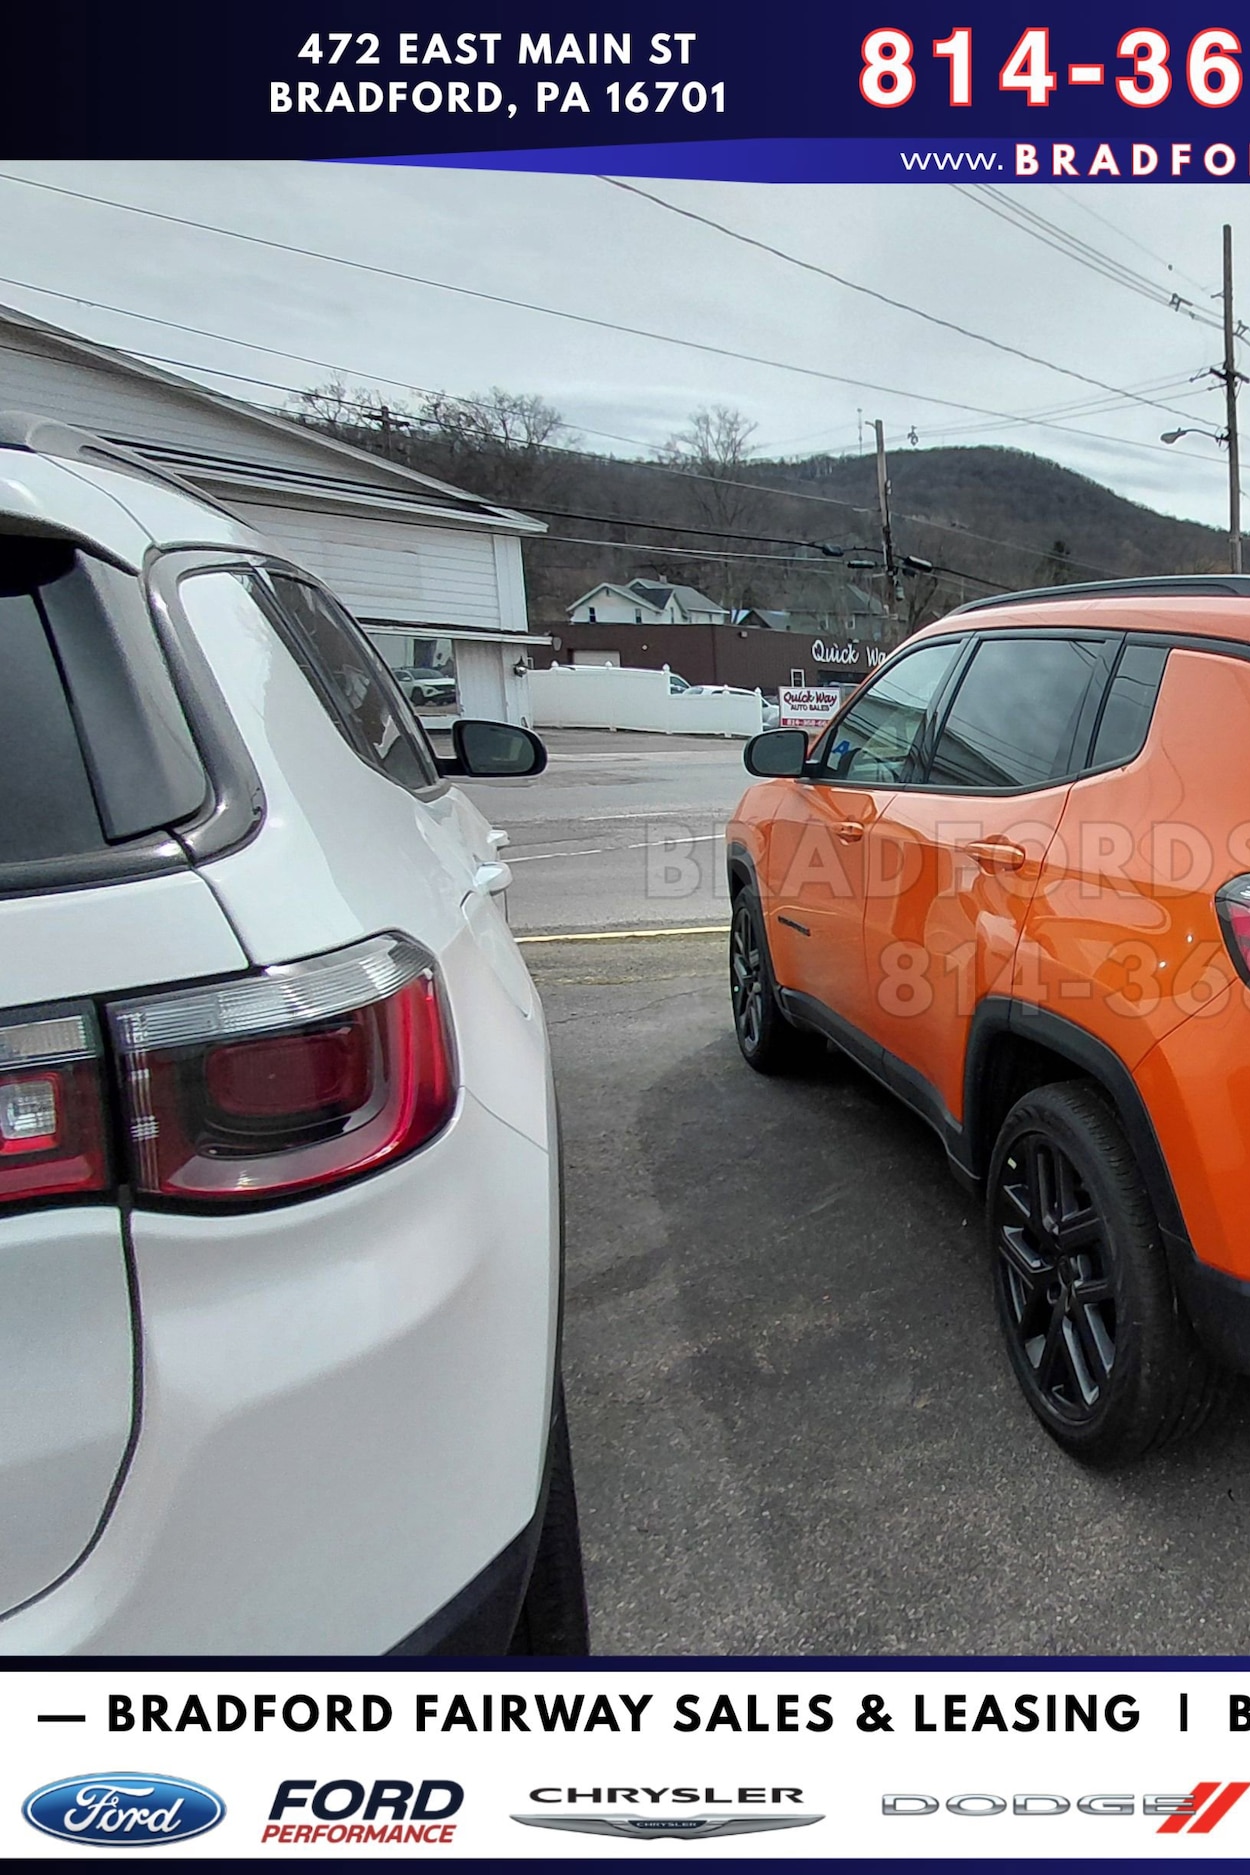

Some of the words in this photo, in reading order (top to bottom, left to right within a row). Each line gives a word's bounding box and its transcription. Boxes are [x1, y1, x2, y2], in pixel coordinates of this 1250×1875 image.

[812, 640, 860, 664] Quick
[866, 646, 886, 667] Wa
[784, 691, 815, 705] Quick
[815, 691, 837, 707] Way
